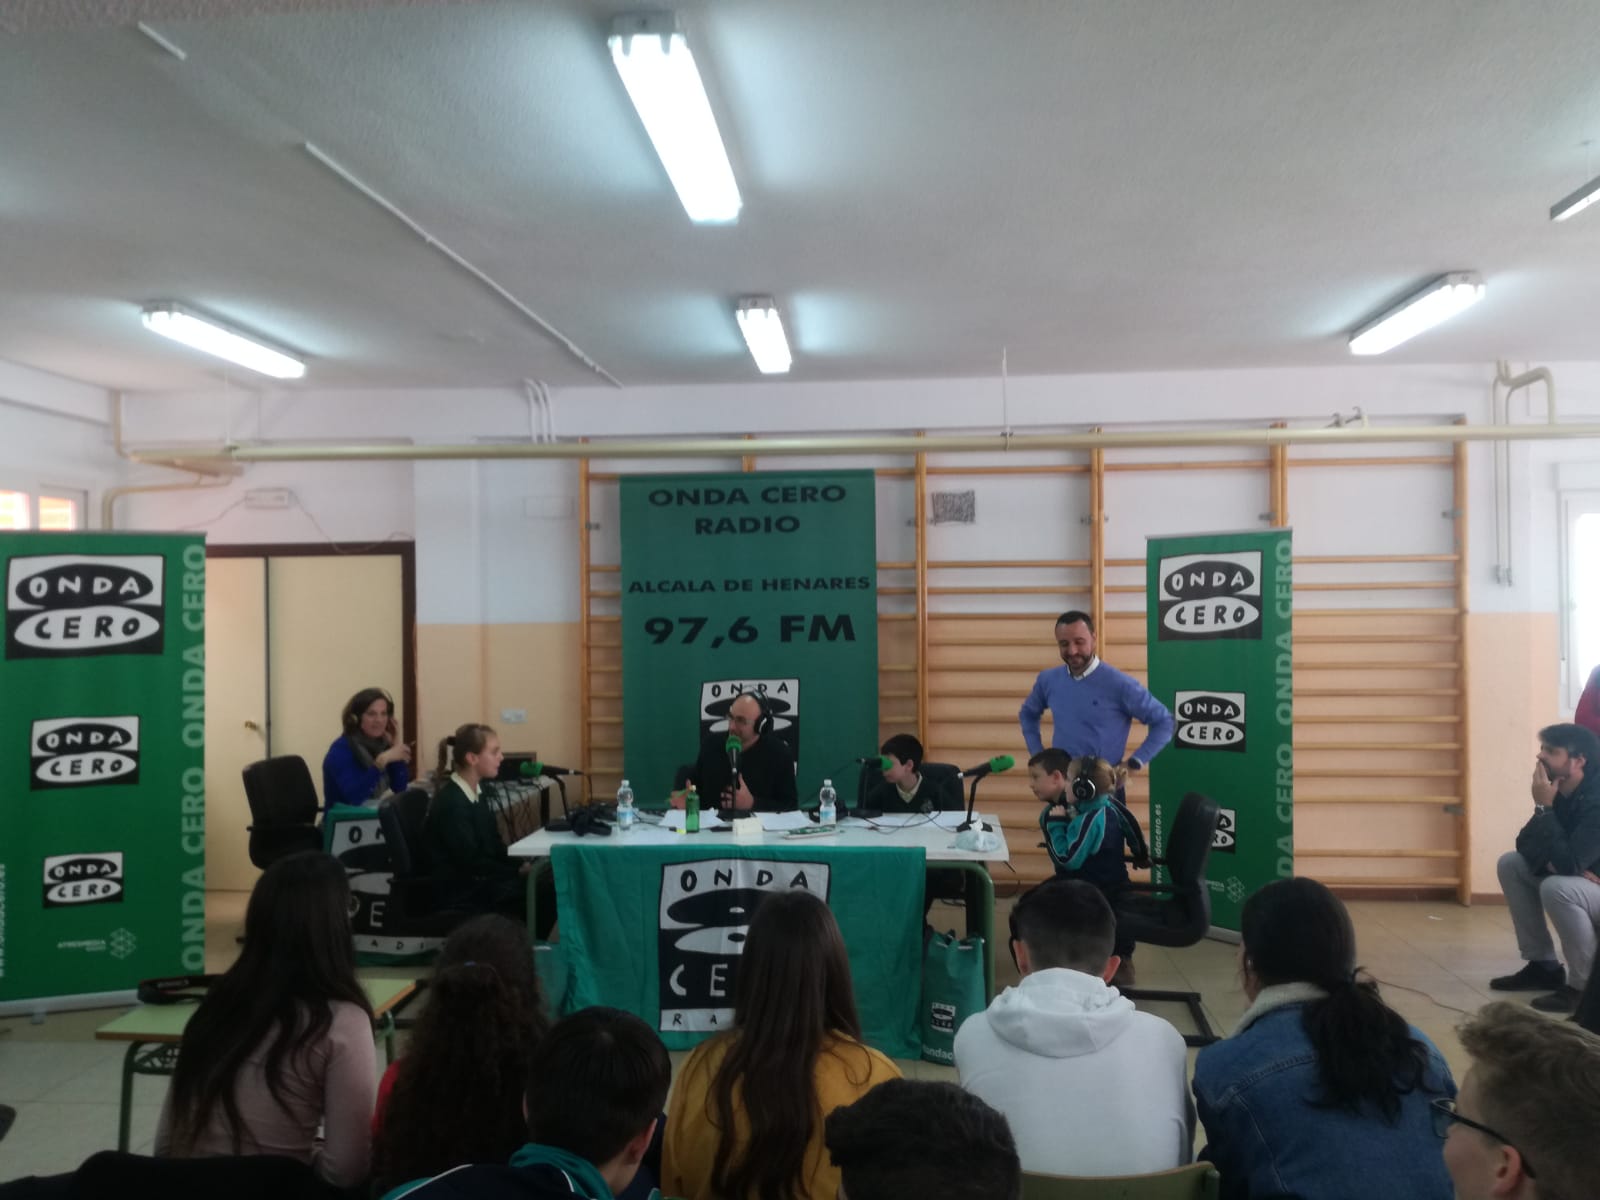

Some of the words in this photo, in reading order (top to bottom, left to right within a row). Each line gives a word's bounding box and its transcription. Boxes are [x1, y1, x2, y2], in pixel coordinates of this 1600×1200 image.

[648, 487, 750, 507] ONDA
[760, 485, 847, 505] CERO
[695, 515, 801, 536] RADIO
[28, 575, 141, 599] ONDA
[181, 544, 206, 632] CERO
[628, 579, 716, 594] ALCALA
[723, 578, 753, 593] DE
[761, 576, 871, 592] HENARES
[1171, 570, 1246, 592] ONDA
[1275, 539, 1293, 620] CERO
[1175, 604, 1246, 626] CERO
[34, 615, 141, 640] CERO
[644, 615, 759, 649] 97,6
[779, 614, 857, 644] FM
[711, 681, 789, 698] ONDA
[1275, 630, 1293, 726] ONDA
[181, 643, 206, 748] ONDA
[1183, 703, 1236, 716] ONDA
[45, 730, 124, 749] ONDA
[1186, 725, 1236, 741] CERO
[49, 758, 123, 777] CERO
[1275, 742, 1294, 824] CERO
[181, 767, 206, 855] CERO
[1276, 834, 1294, 878] DA
[53, 863, 113, 878] ONDA
[680, 868, 809, 893] ONDA
[56, 883, 112, 899] CERO
[181, 865, 206, 971] ONDA
[669, 963, 729, 997] CE
